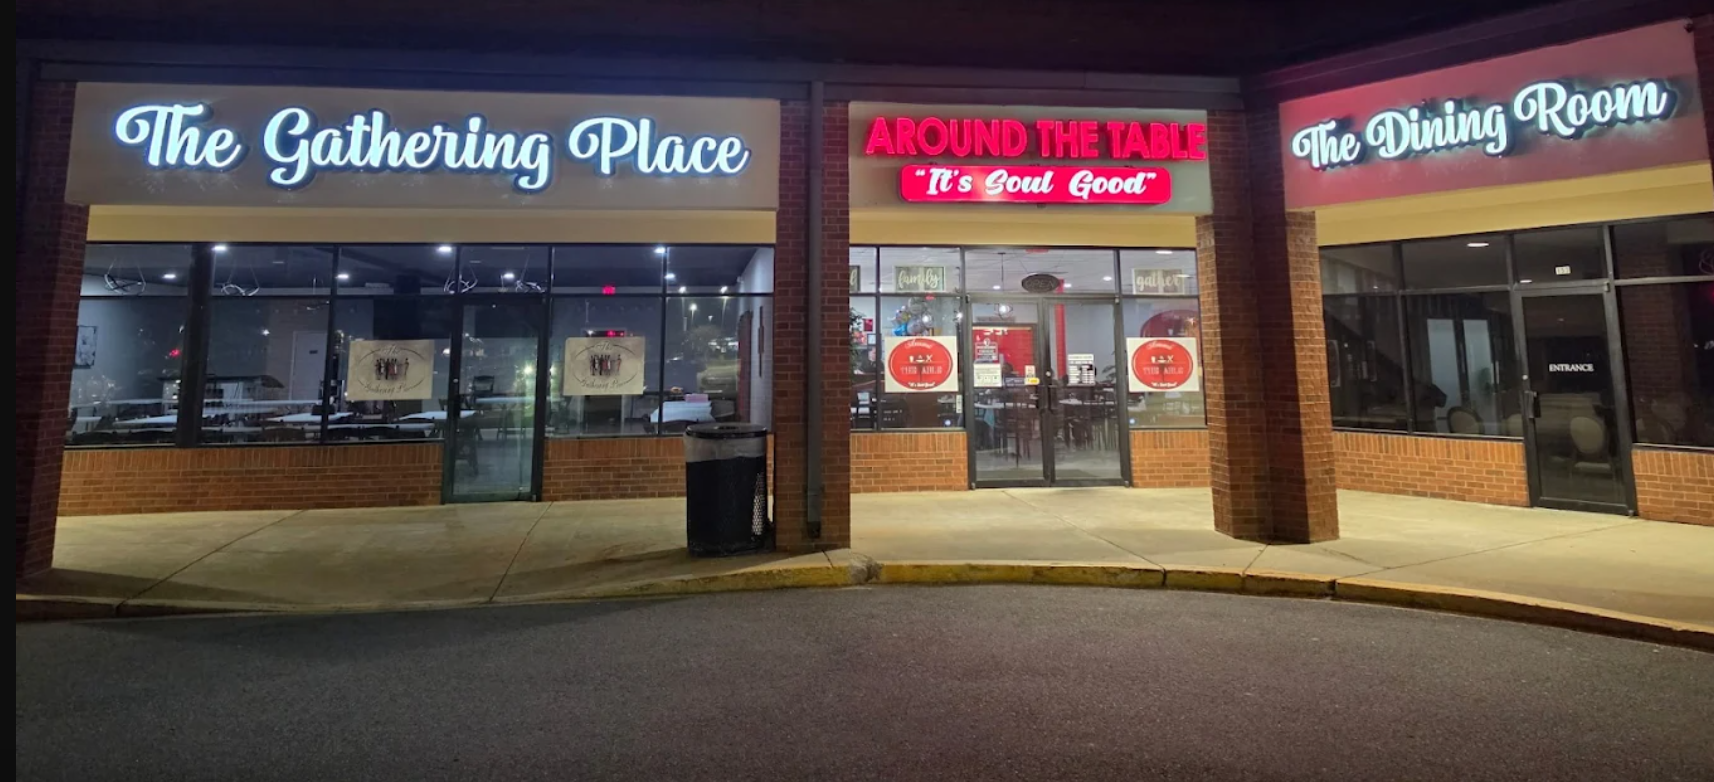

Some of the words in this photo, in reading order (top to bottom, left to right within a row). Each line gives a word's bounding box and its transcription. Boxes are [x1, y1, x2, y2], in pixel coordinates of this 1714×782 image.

[866, 117, 1028, 158] AROUND
[1036, 119, 1099, 158] THE
[1107, 122, 1207, 160] TABLE
[1291, 120, 1361, 170] The
[1365, 101, 1507, 158] Dining
[1513, 81, 1668, 136] Room
[116, 104, 241, 168] The
[264, 107, 550, 190] Gathering
[568, 117, 749, 175] Place
[984, 170, 1054, 195] Soul
[1068, 169, 1157, 200] Good"
[898, 269, 940, 289] family
[1136, 270, 1180, 291] gather
[1549, 363, 1594, 372] ENTRANCE
